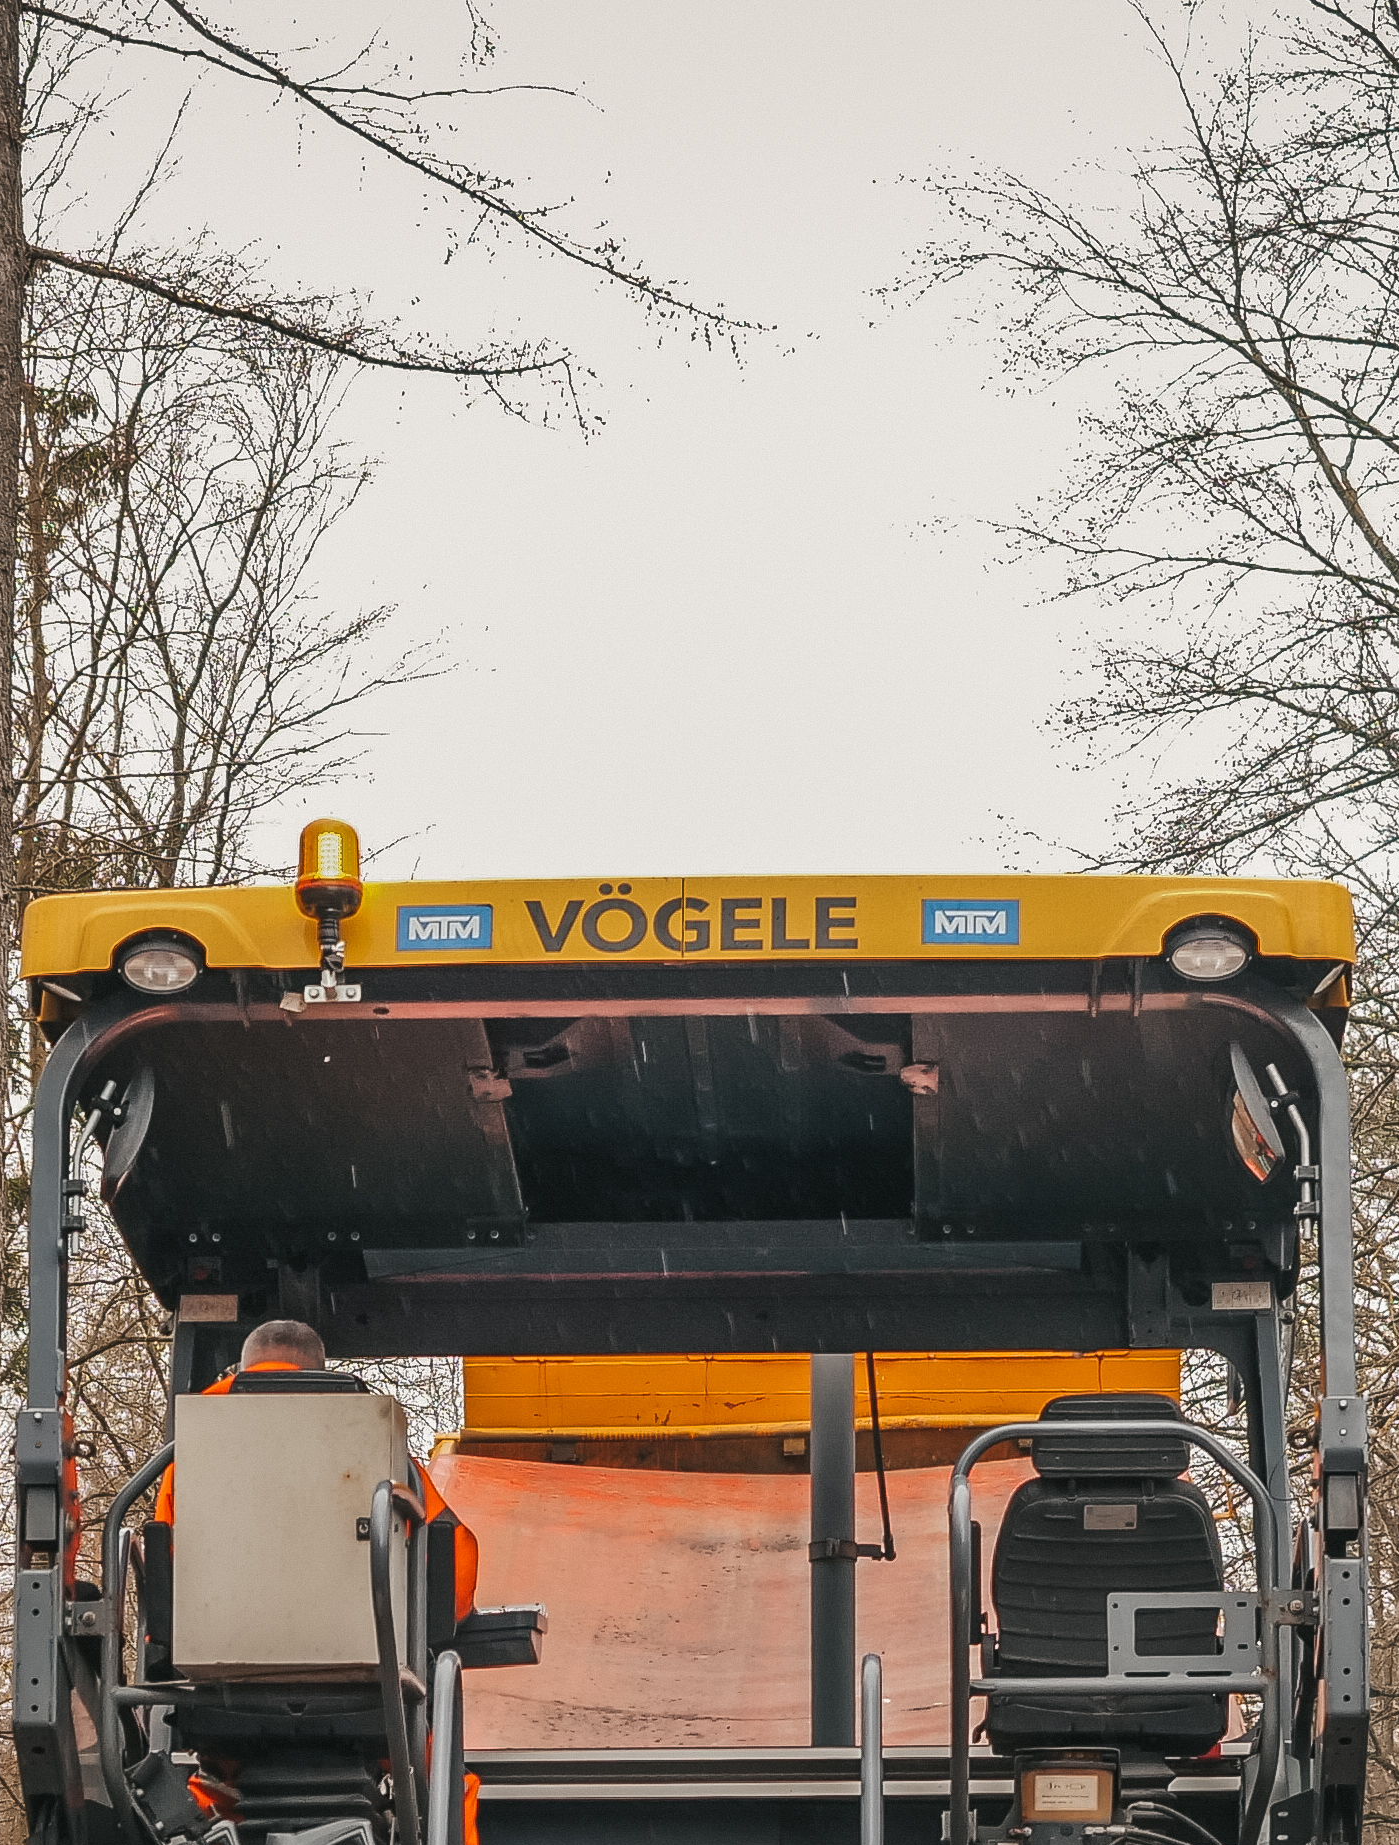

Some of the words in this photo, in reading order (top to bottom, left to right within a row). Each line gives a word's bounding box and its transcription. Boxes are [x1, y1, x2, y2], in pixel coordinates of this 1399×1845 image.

[408, 915, 480, 940] MTM
[524, 883, 858, 953] VÖGELE
[935, 910, 1006, 934] MTM
